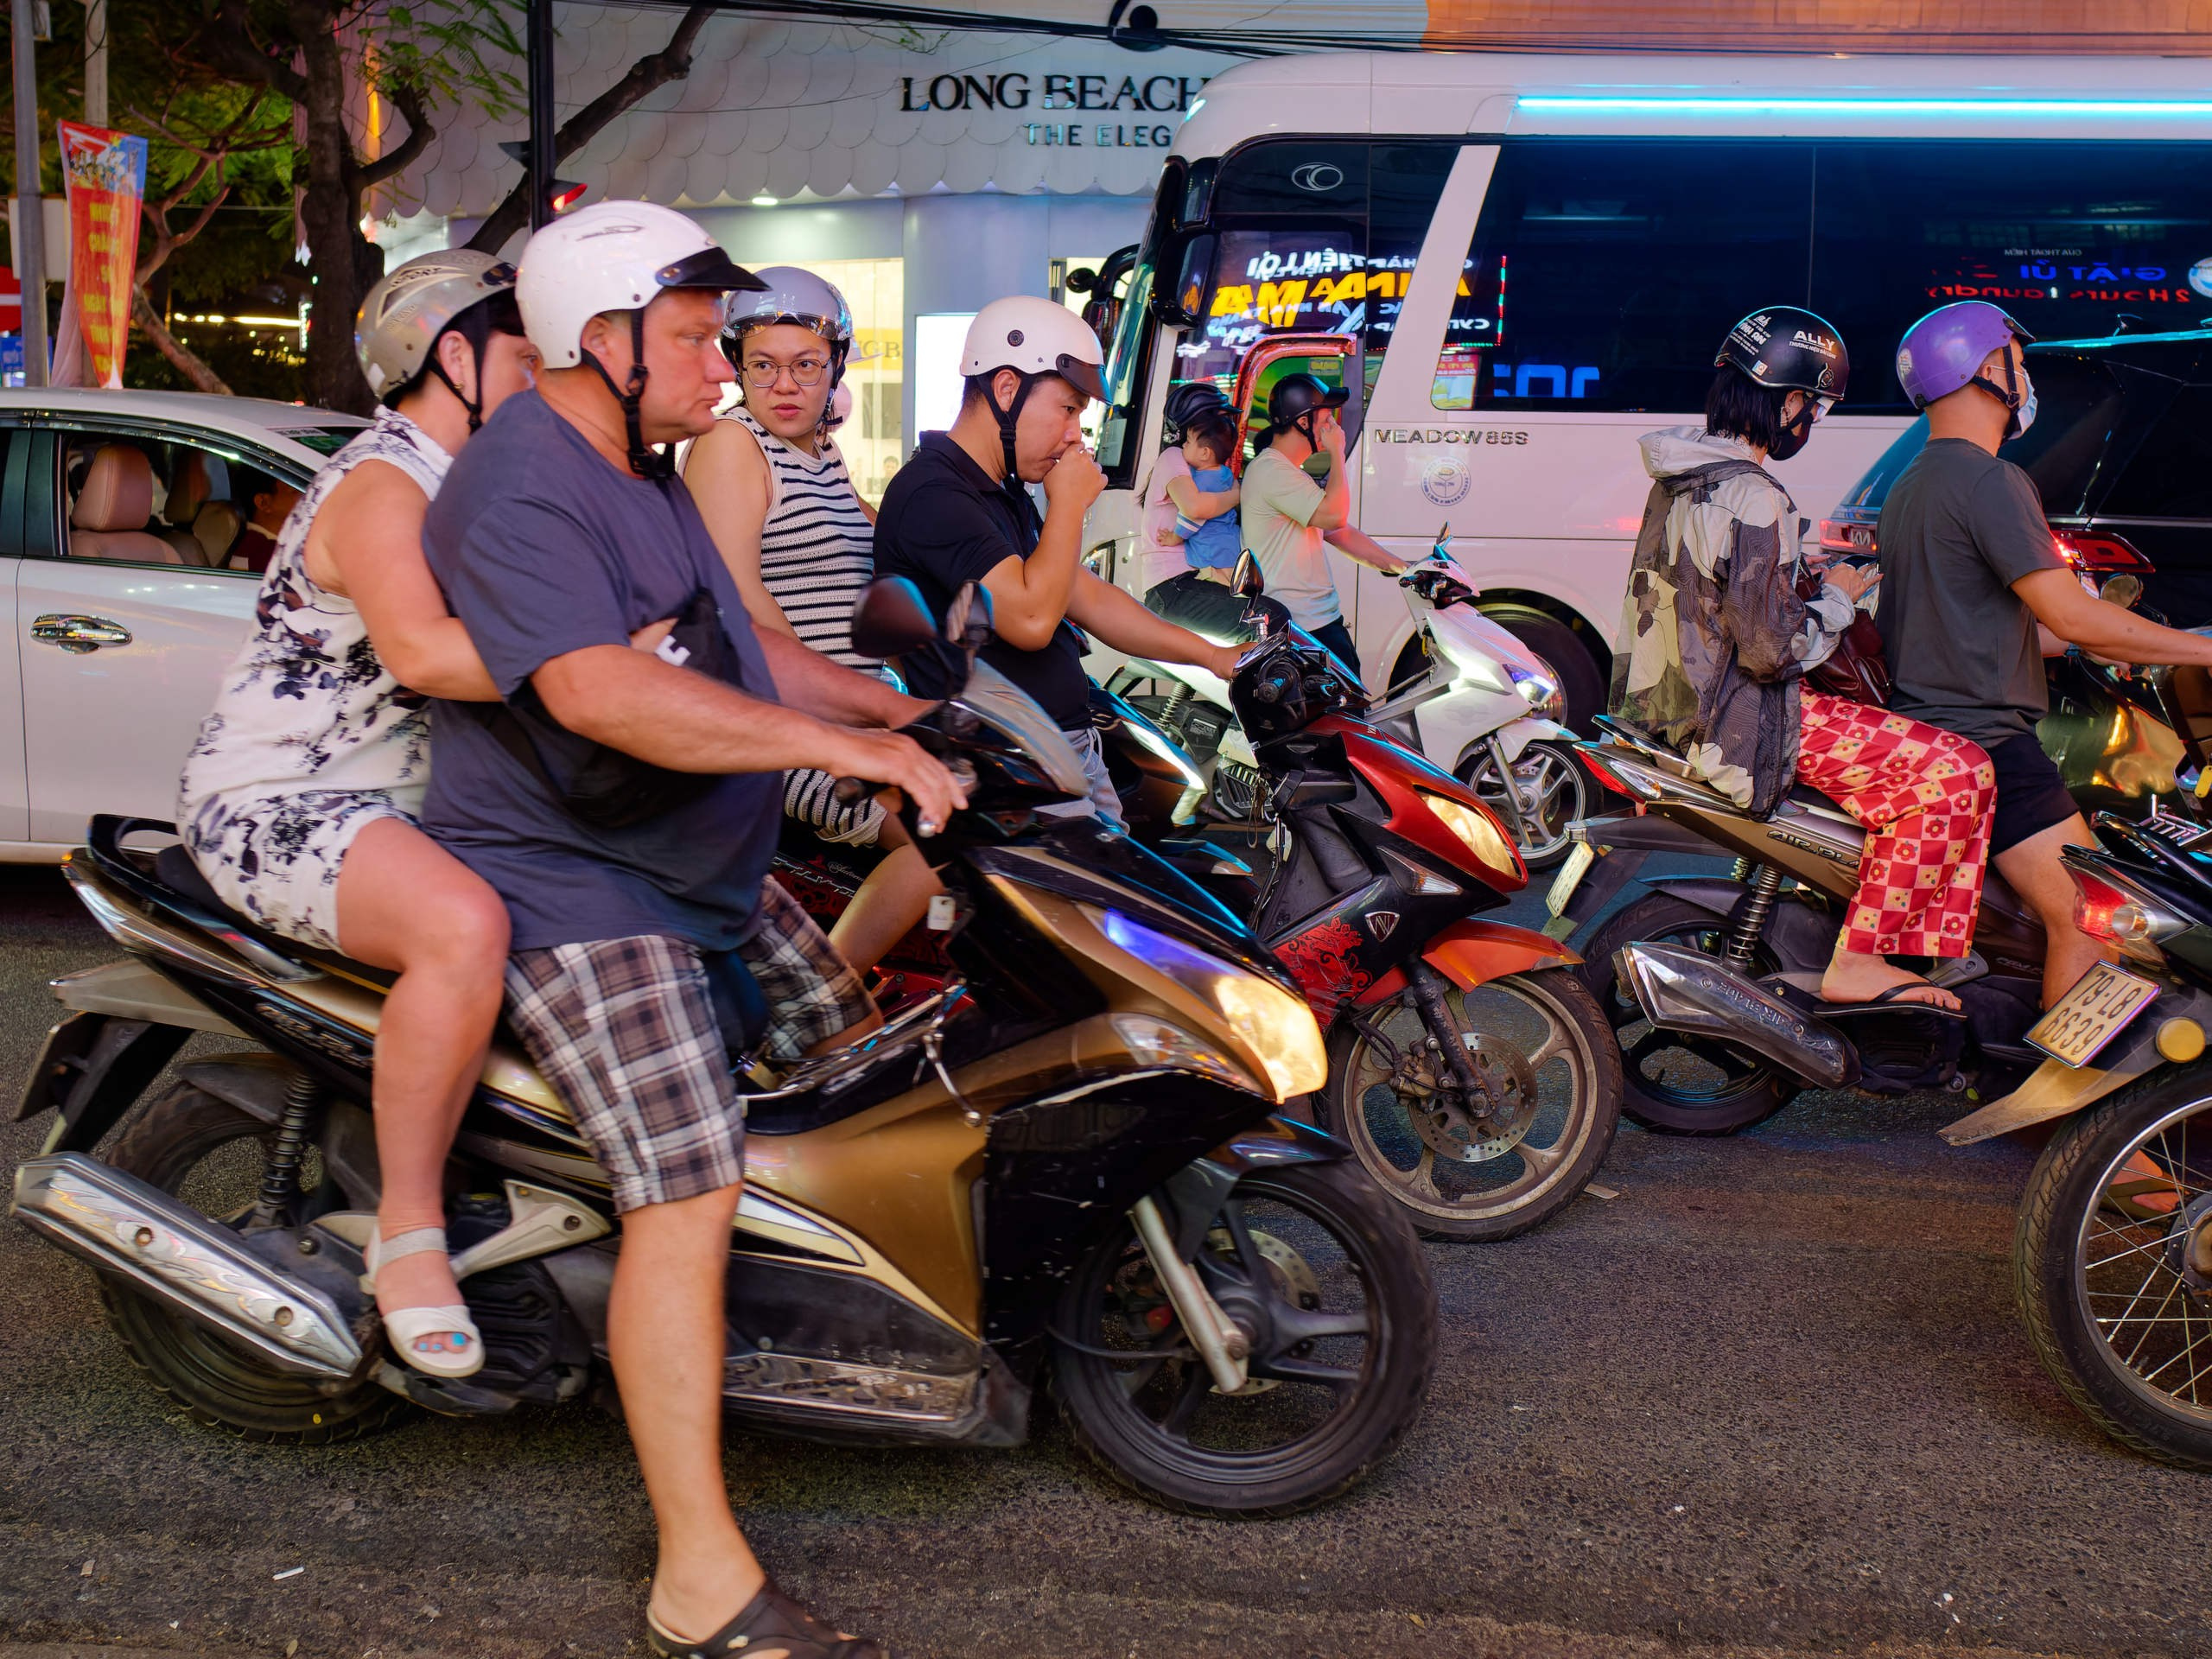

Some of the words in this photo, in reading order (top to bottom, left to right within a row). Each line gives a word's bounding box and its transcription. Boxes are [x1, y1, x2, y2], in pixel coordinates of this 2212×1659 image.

[899, 73, 1030, 111] LONG
[1043, 74, 1211, 112] BEACH
[1023, 123, 1082, 147] THE
[1096, 124, 1172, 148] ELEG
[1793, 330, 1836, 352] ALLY
[1374, 429, 1483, 444] MEADOW
[1486, 430, 1529, 445] 85S
[1817, 846, 1859, 869] BLA
[2042, 1007, 2105, 1056] 6639
